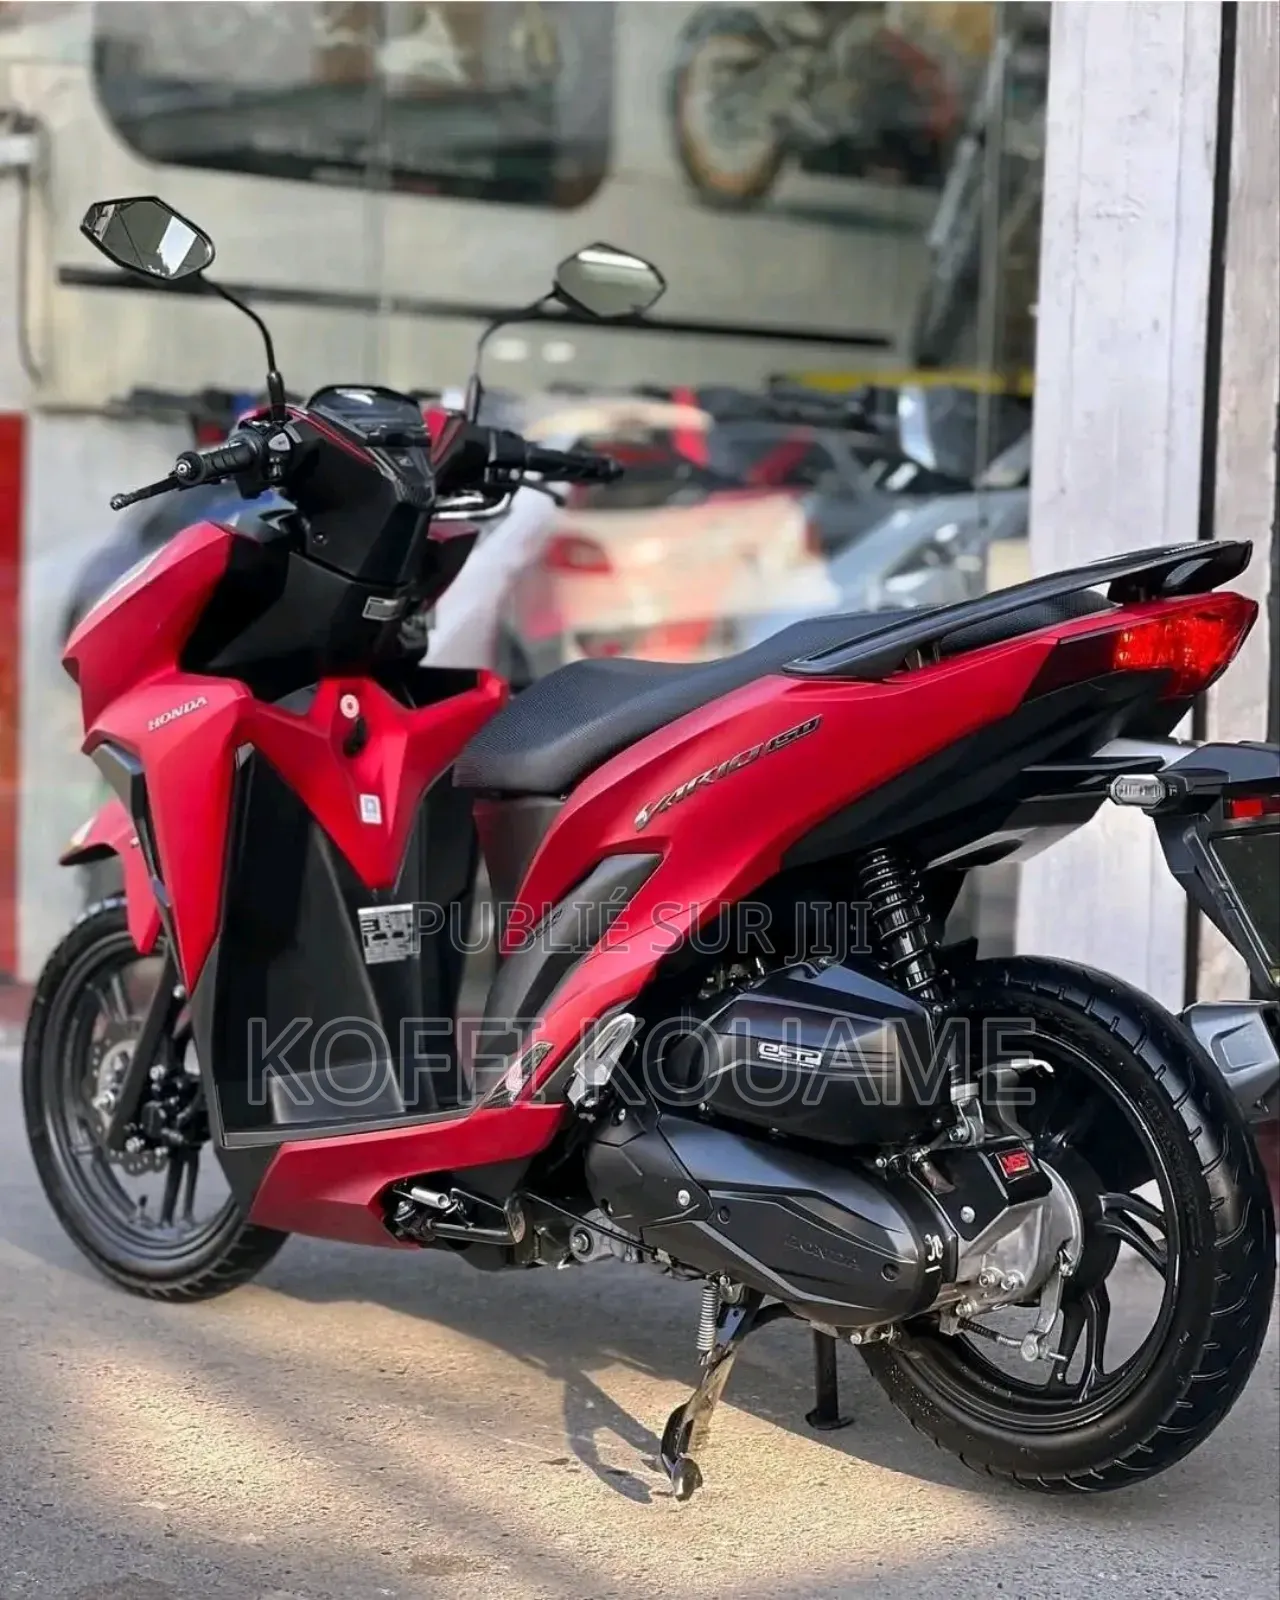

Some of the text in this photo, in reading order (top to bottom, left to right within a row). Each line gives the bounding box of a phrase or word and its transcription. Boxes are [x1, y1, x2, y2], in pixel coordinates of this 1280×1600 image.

[146, 695, 208, 734] HONDA
[634, 713, 824, 833] VARIO 150
